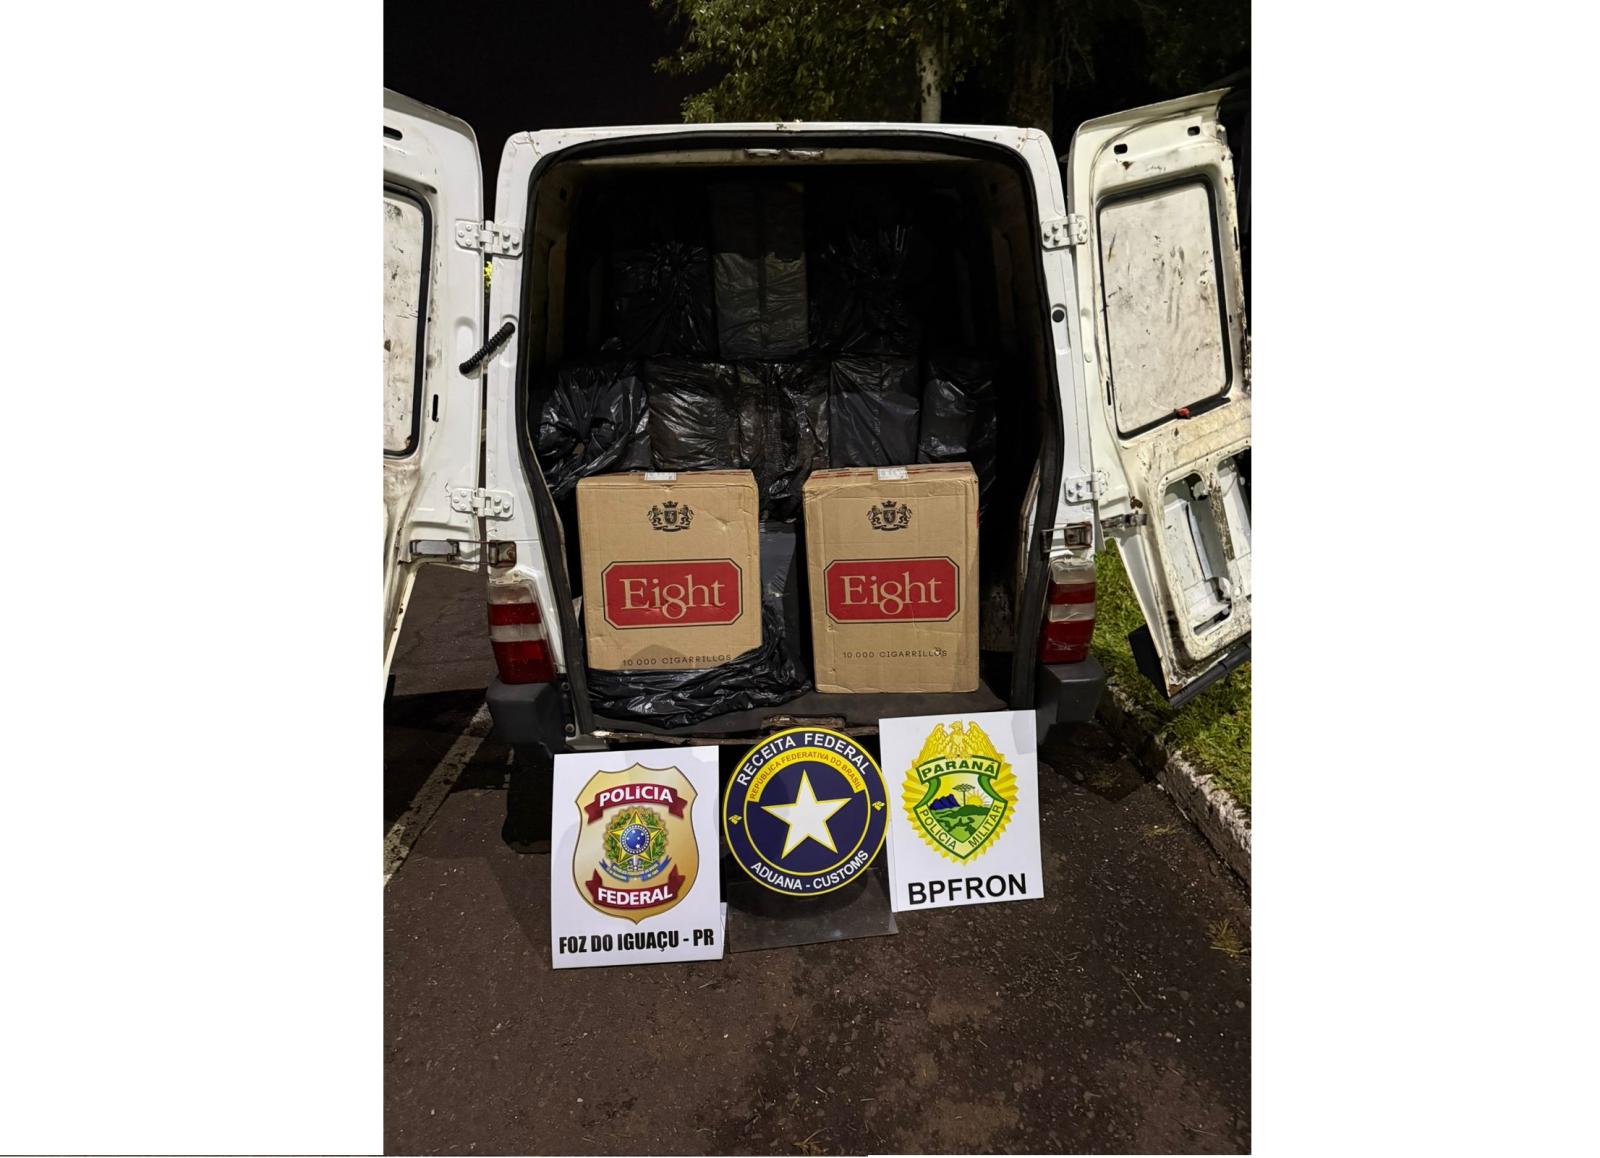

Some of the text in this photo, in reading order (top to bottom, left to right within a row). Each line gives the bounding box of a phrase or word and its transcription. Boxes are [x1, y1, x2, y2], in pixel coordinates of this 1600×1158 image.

[619, 574, 727, 620] Eight
[840, 571, 942, 616] Eight
[661, 654, 732, 665] CIGARRILLOS
[879, 649, 948, 659] CIGARRILLOS
[737, 733, 870, 786] RECEITA FEDERAL
[781, 751, 829, 764] FEDERATIVA
[830, 757, 842, 767] DO
[841, 764, 862, 789] BRASIL
[921, 760, 995, 778] PARANÁ
[968, 804, 1001, 848] MILITAR
[750, 861, 802, 890] ADUANA
[813, 849, 869, 889] CUSTOMS
[598, 885, 673, 906] FEDERAL
[908, 873, 1027, 905] BPFRON
[559, 935, 588, 954] FOZ
[590, 934, 613, 952] DO
[617, 930, 679, 952] IGUAÇU
[693, 928, 714, 946] PR
